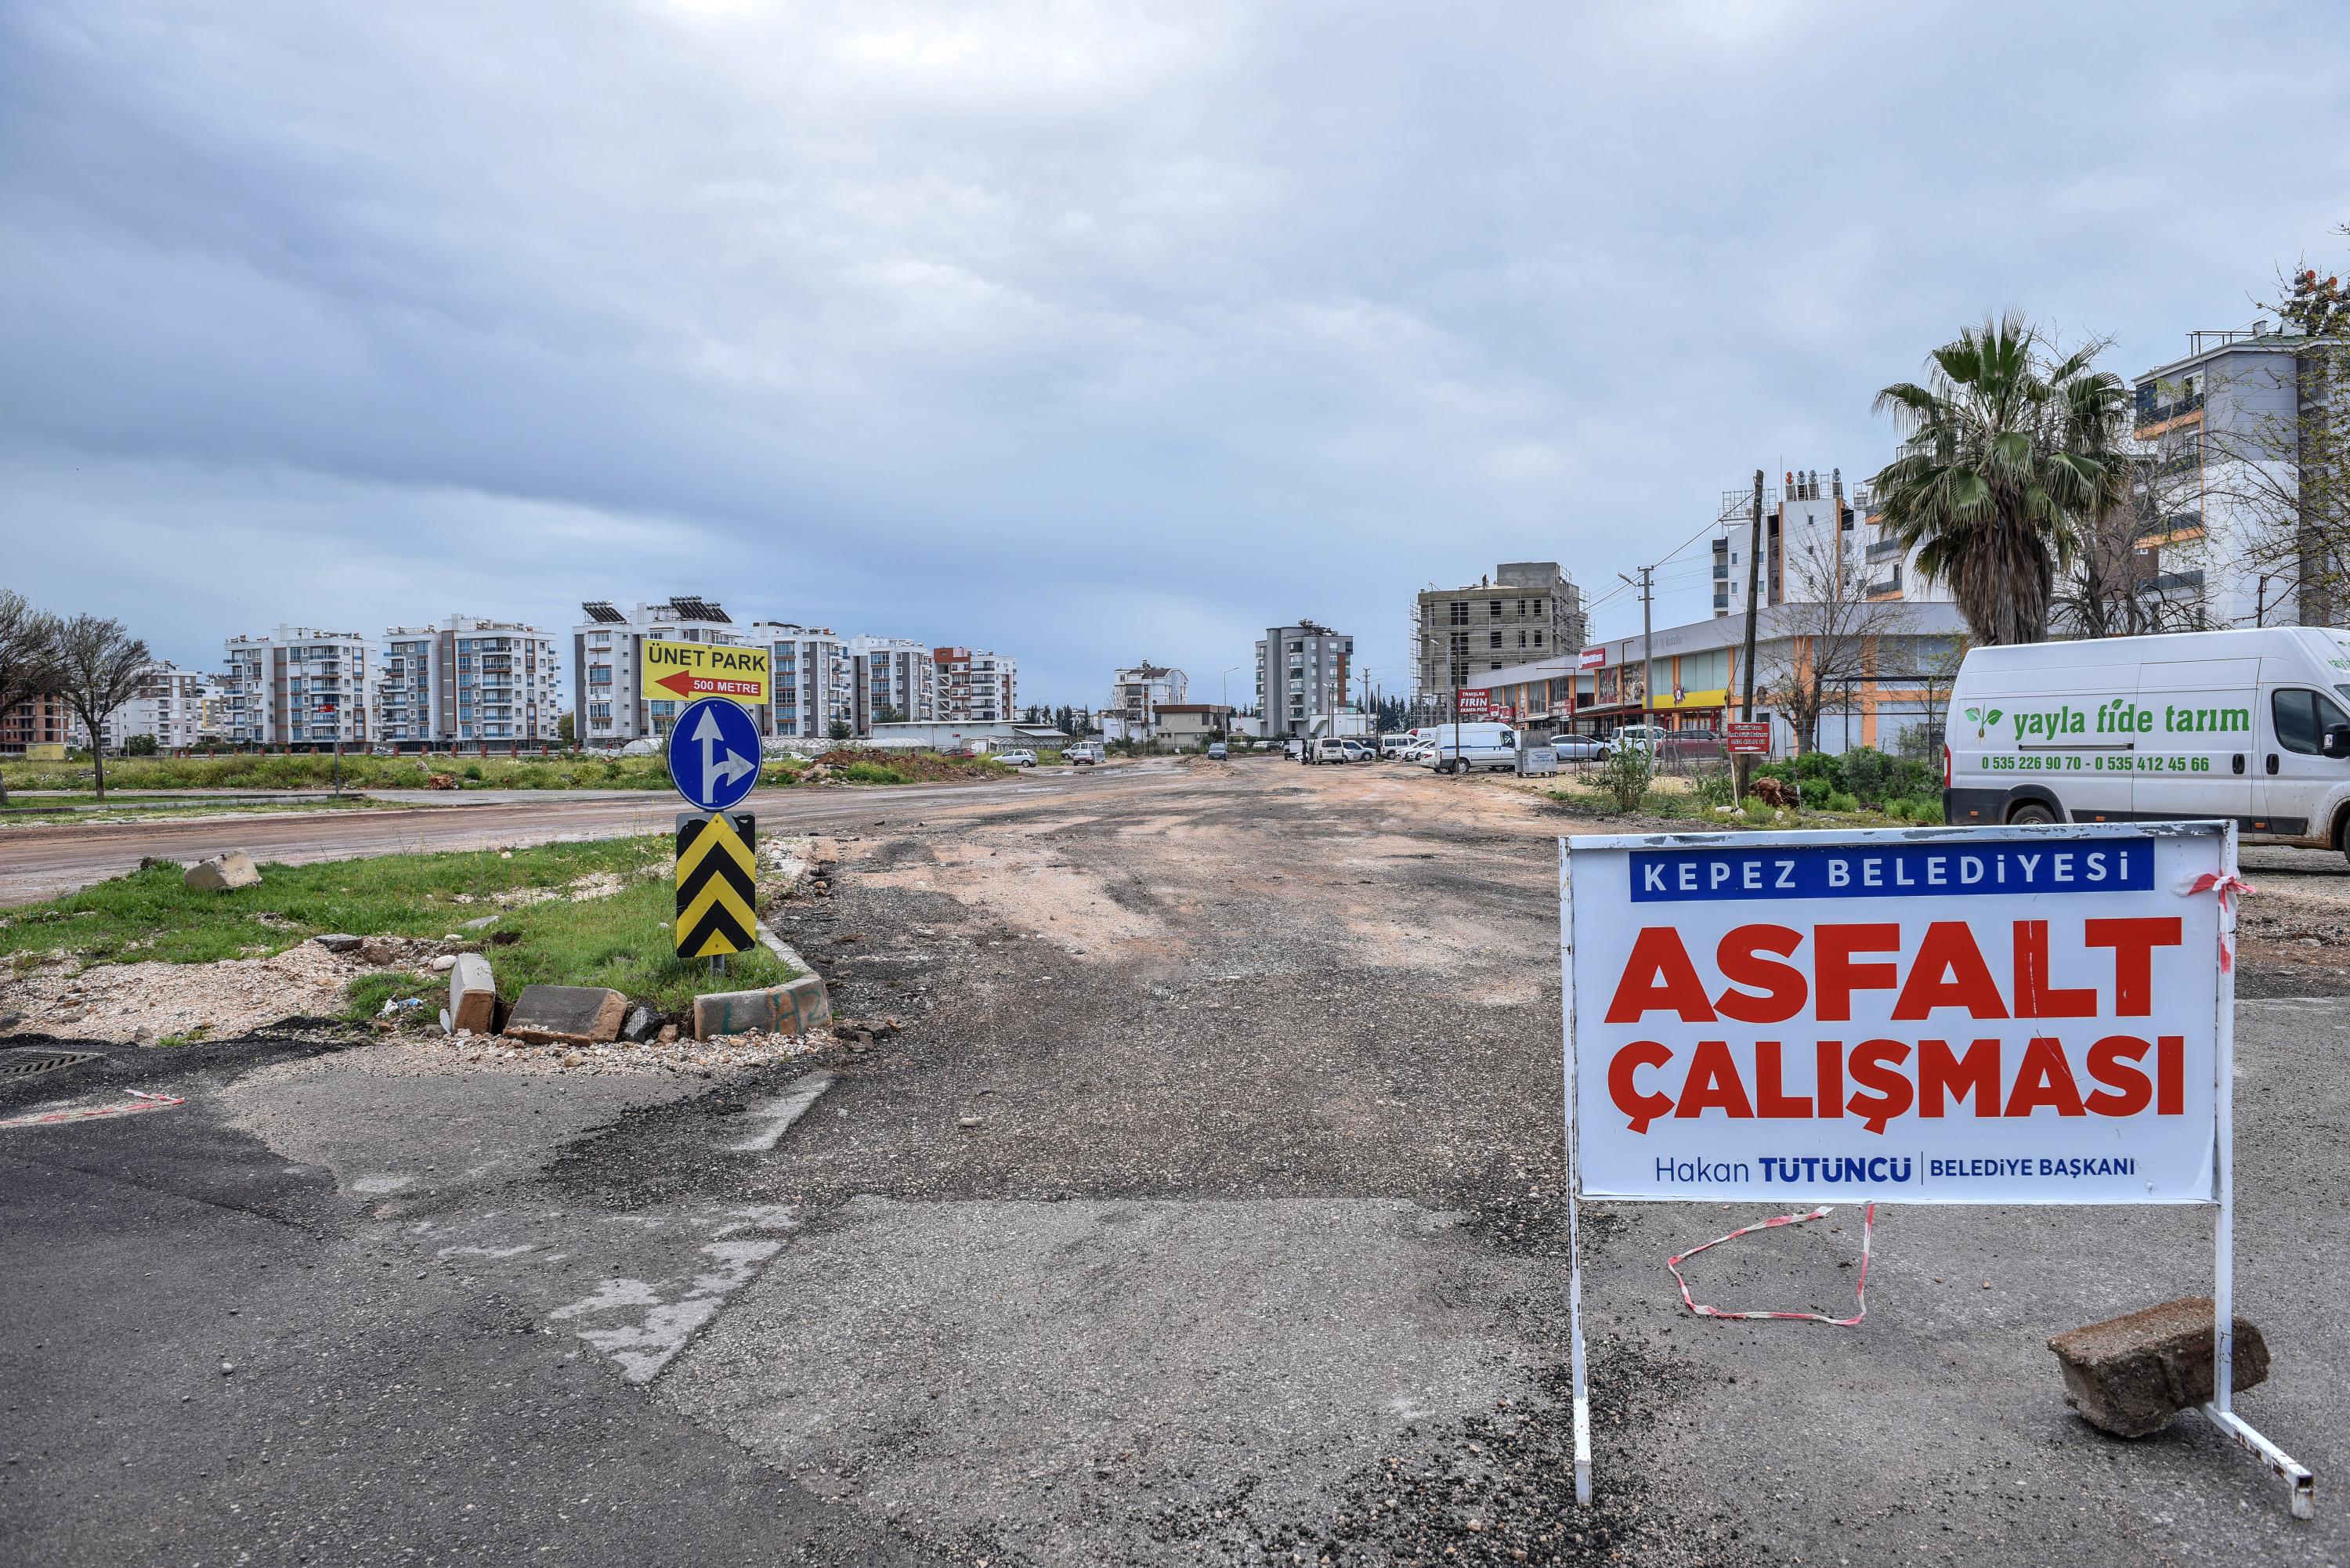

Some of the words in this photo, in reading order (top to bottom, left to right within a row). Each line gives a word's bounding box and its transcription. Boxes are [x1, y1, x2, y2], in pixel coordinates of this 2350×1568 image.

[649, 642, 705, 667] ÜNET
[711, 651, 766, 672] PARK
[693, 680, 714, 691] 500
[718, 681, 758, 694] METRE
[1460, 698, 1488, 707] FIRIN
[2013, 706, 2085, 741] yayla
[2096, 699, 2153, 733] fide
[2165, 705, 2250, 732] tarım
[1982, 756, 1989, 770] 0
[1993, 756, 2016, 770] 535
[2019, 756, 2041, 770] 226
[2045, 756, 2061, 770] 90
[2065, 756, 2081, 770] 70
[2095, 756, 2103, 771] 0
[2107, 756, 2132, 771] 535
[2137, 757, 2164, 771] 412
[2167, 757, 2186, 771] 45
[2191, 757, 2209, 771] 66
[1644, 860, 1796, 891] KEPEZ
[1828, 851, 2128, 887] BELEDİYESİ
[1604, 917, 2182, 1024] ASFALT
[1607, 1035, 2184, 1136] ÇALIŞMASI
[1656, 1157, 1749, 1183] Hakan
[1759, 1157, 1911, 1183] TÜTÜNCÜ
[1930, 1158, 2034, 1176] BELEDİYE
[2039, 1158, 2135, 1178] BAŞKANI
